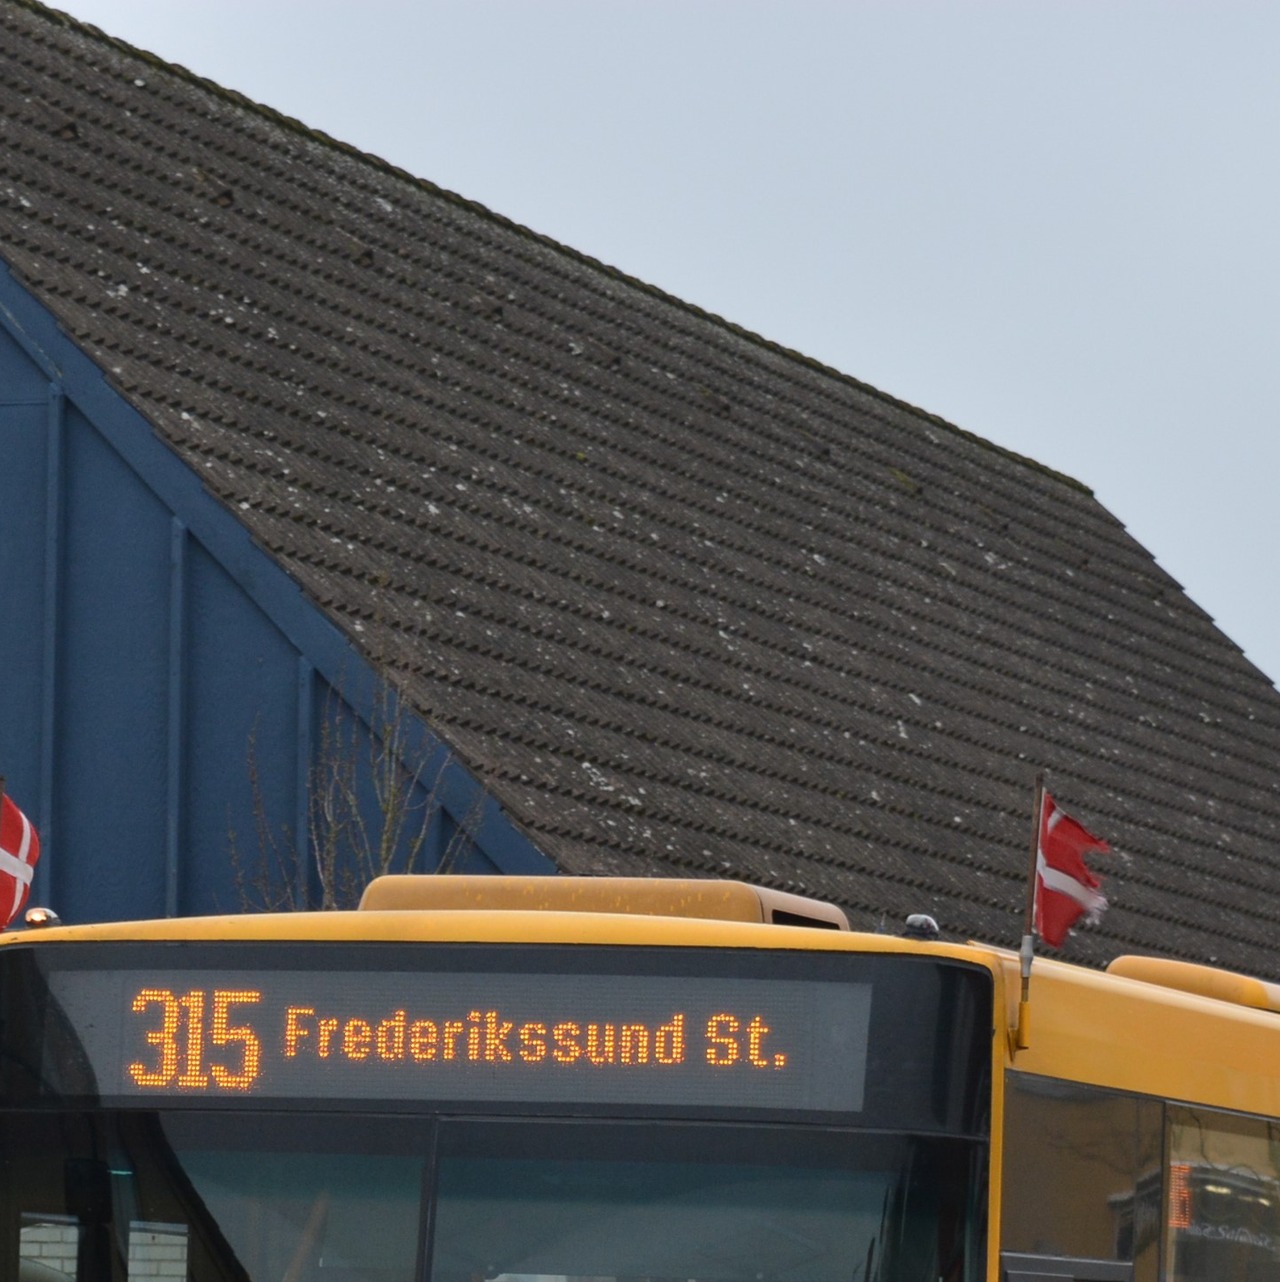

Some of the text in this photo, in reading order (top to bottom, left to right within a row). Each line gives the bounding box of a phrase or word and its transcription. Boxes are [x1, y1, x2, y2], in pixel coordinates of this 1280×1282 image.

[128, 987, 787, 1092] 315 Frederikssund St.
